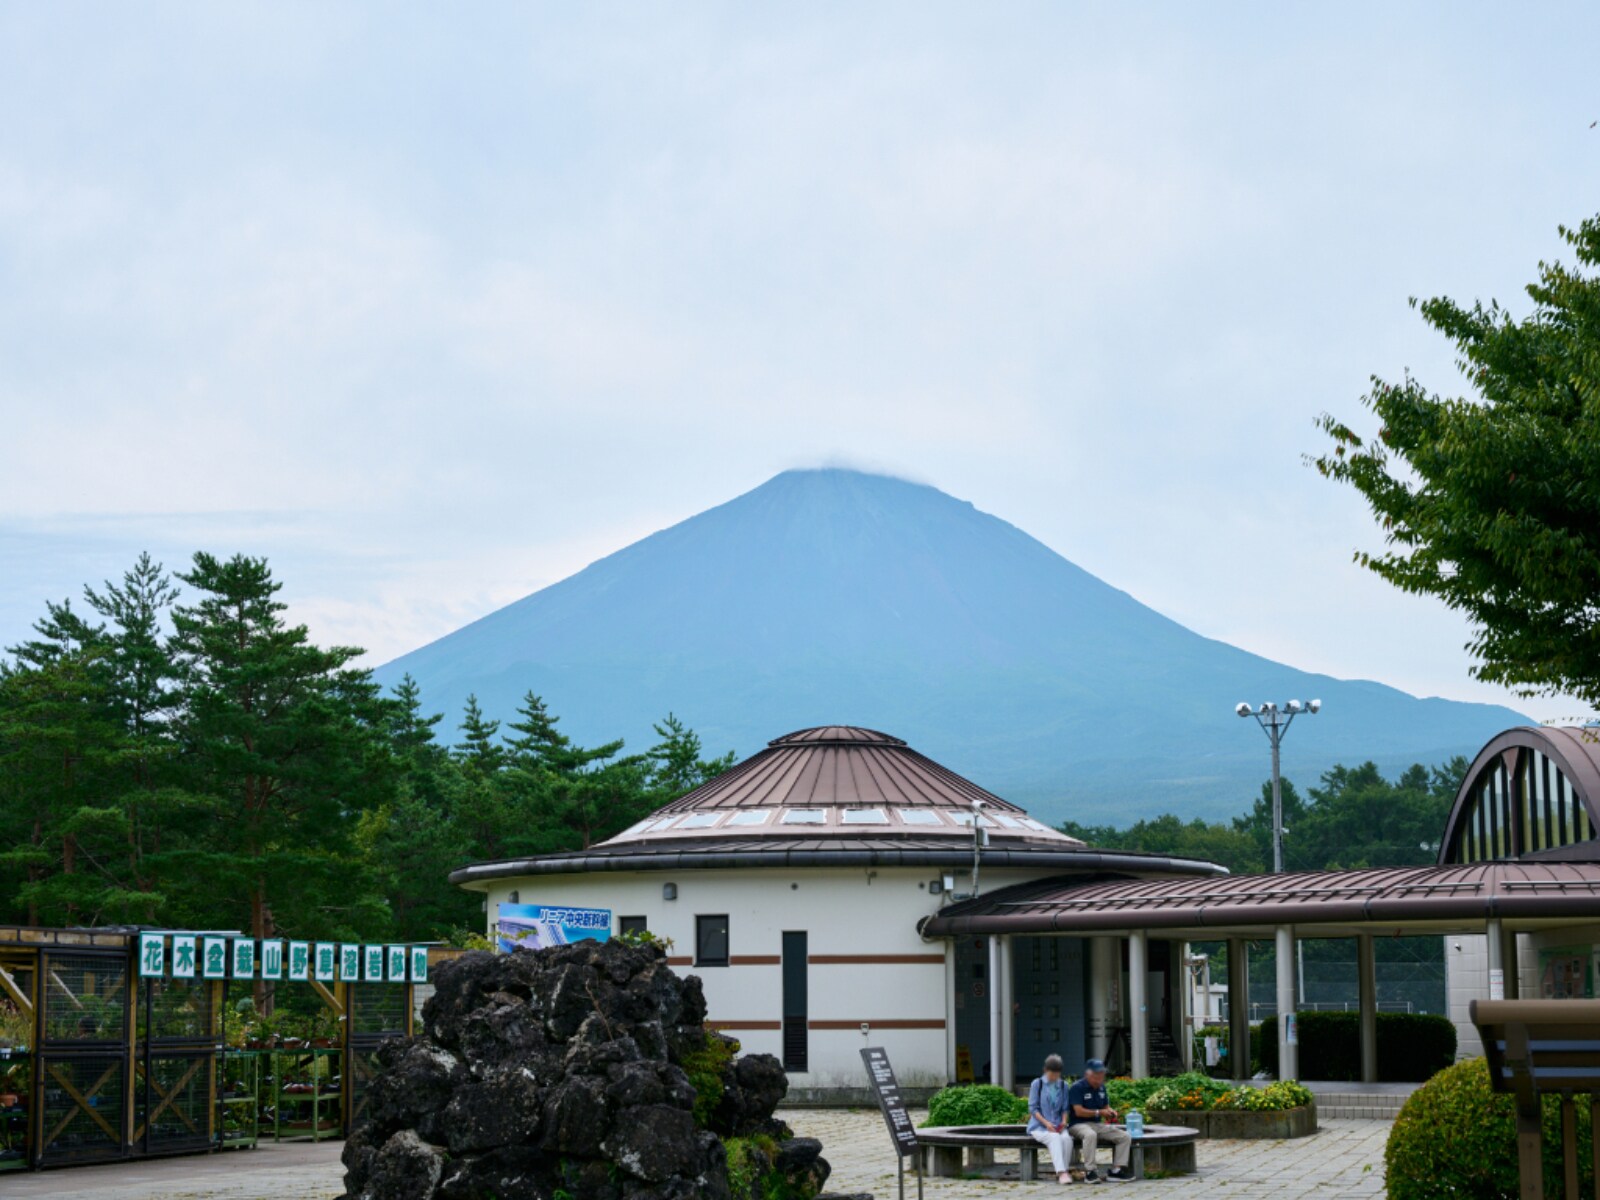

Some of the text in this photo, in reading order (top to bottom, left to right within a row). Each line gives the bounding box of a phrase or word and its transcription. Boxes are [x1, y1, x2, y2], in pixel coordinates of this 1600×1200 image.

[540, 909, 610, 929] リニア中央新幹線
